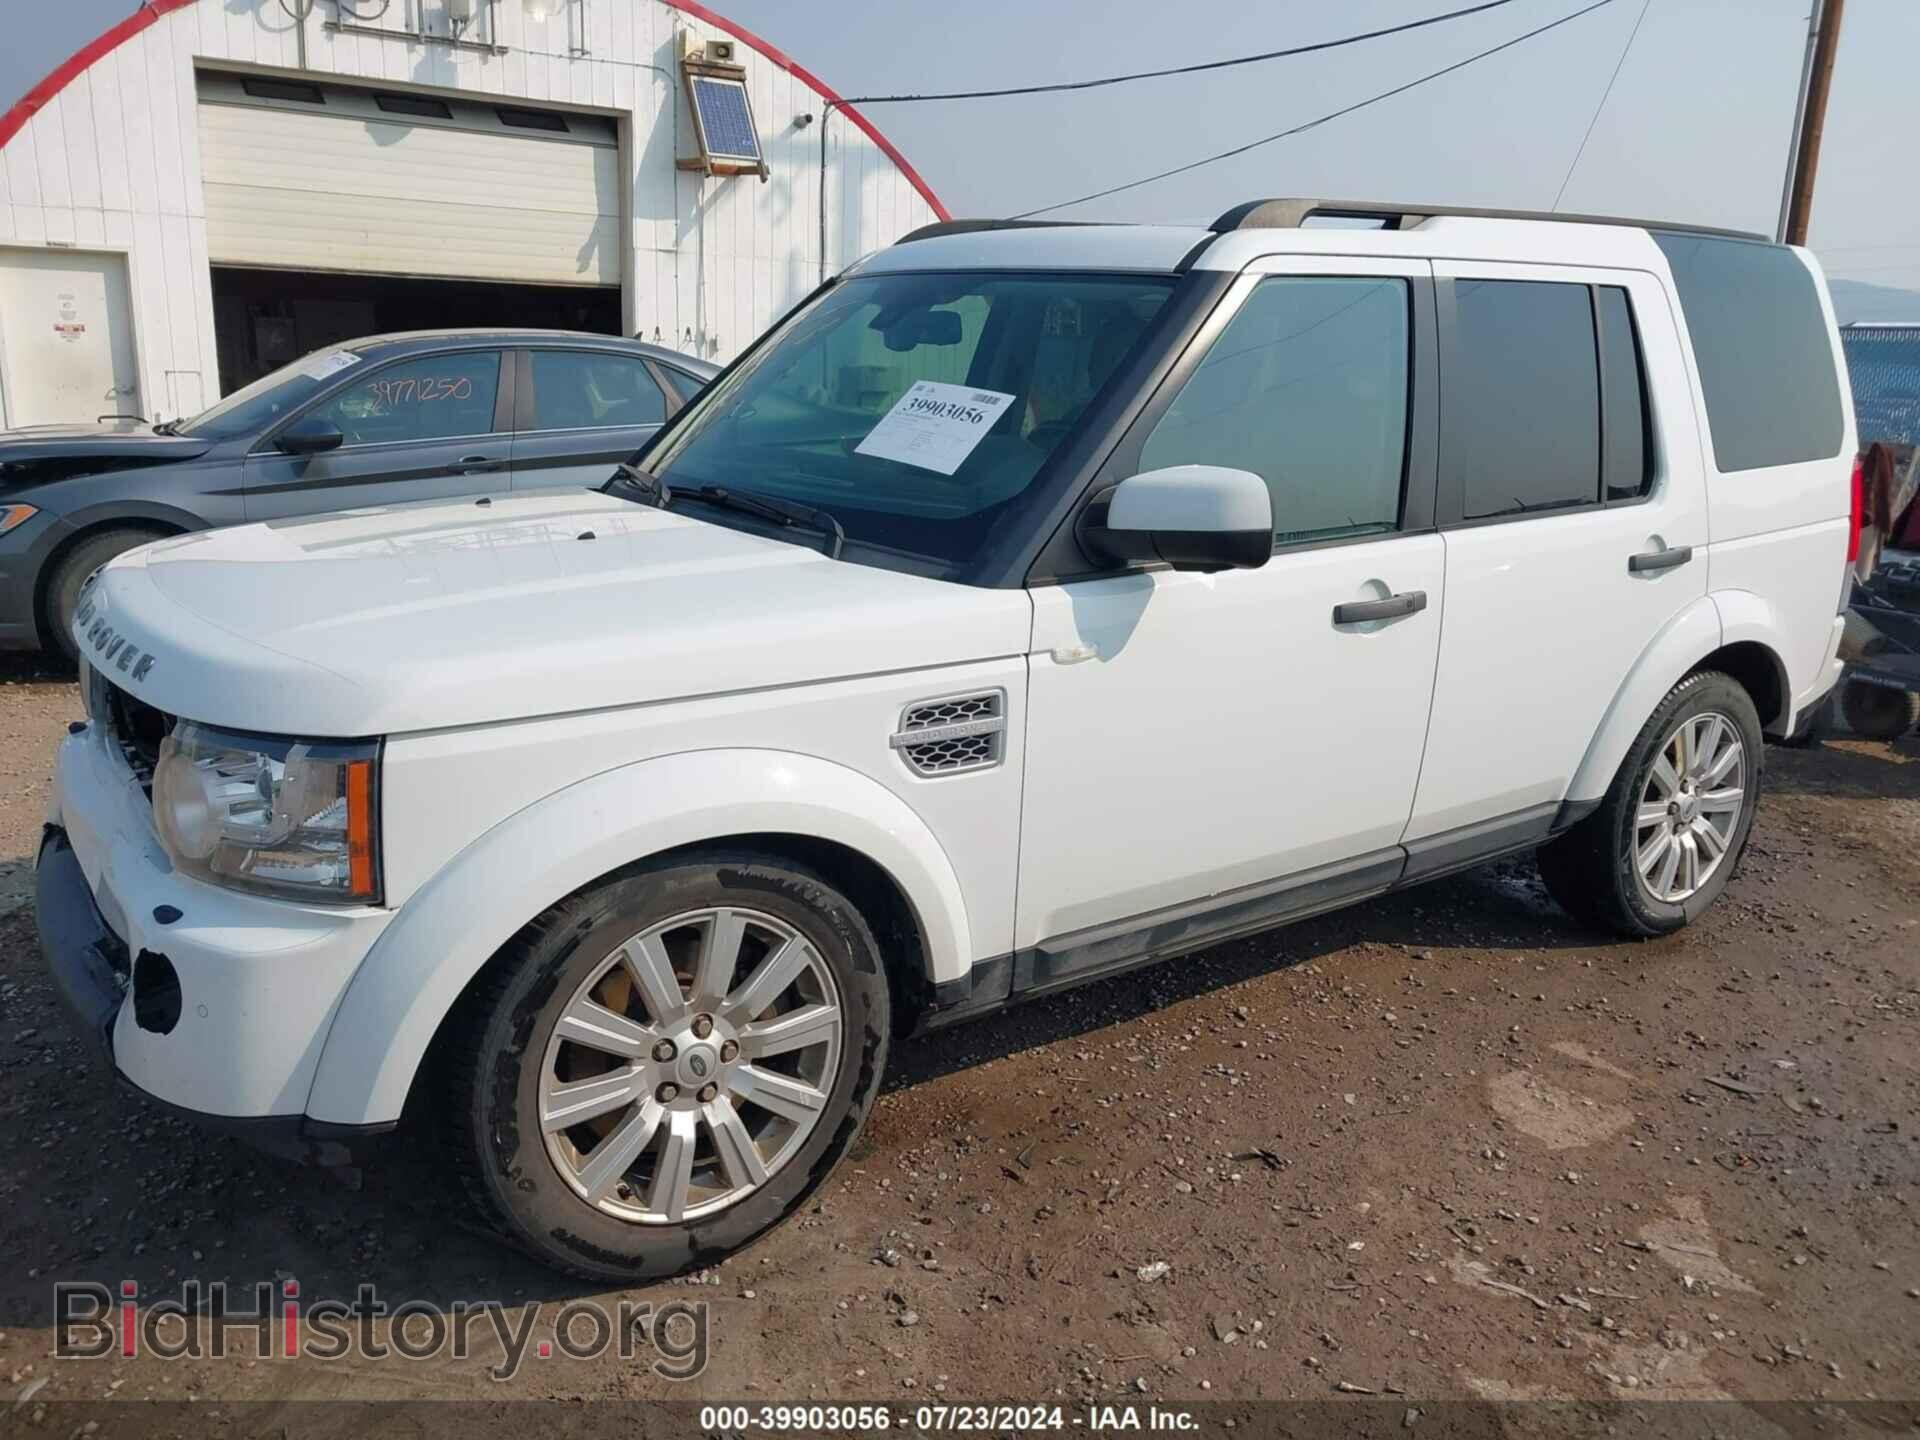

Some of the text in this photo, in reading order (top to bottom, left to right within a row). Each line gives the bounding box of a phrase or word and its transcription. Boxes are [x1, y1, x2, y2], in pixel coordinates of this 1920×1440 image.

[367, 377, 472, 409] 39771250
[902, 397, 987, 425] 39903056
[87, 616, 156, 683] ROVER
